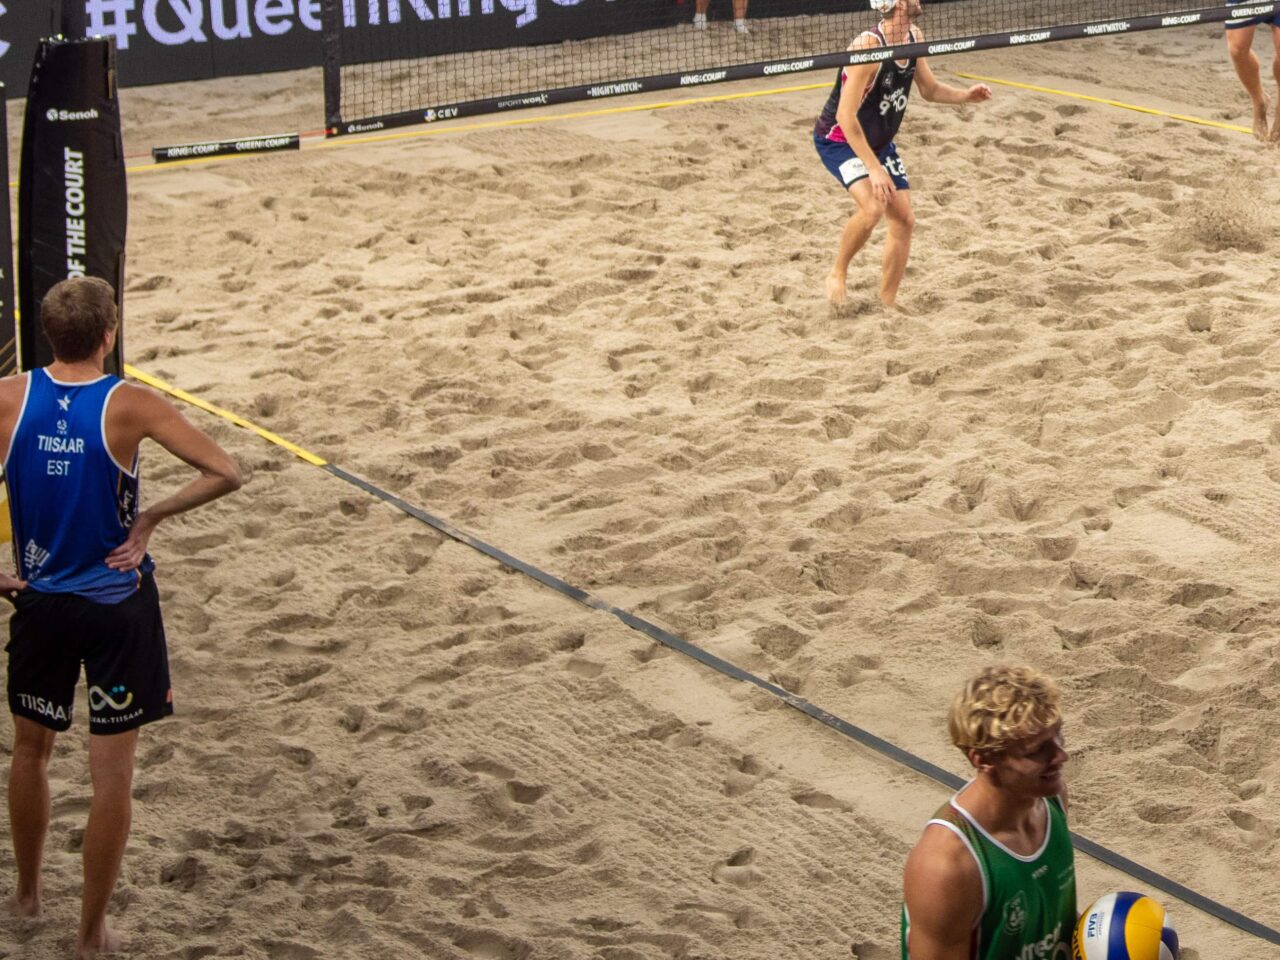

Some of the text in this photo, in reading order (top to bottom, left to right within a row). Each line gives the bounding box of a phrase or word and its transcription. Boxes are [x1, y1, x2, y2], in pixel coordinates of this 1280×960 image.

[1087, 23, 1126, 34] NIGHTWATCH
[928, 40, 976, 55] QUEEN COURT
[850, 51, 893, 63] KING COURT
[763, 60, 814, 75] QUEEN COURT
[680, 71, 726, 86] KING COURT
[591, 83, 639, 97] NIGHTWATCH
[59, 108, 98, 121] Senoh
[437, 108, 458, 119] CEV
[168, 144, 219, 157] KING COURT
[235, 138, 290, 151] QUEEN COURT
[64, 147, 84, 216] COURT
[66, 219, 86, 256] THE
[37, 434, 84, 454] TIISAAR
[47, 460, 71, 476] EST
[1088, 912, 1098, 938] FIVB
